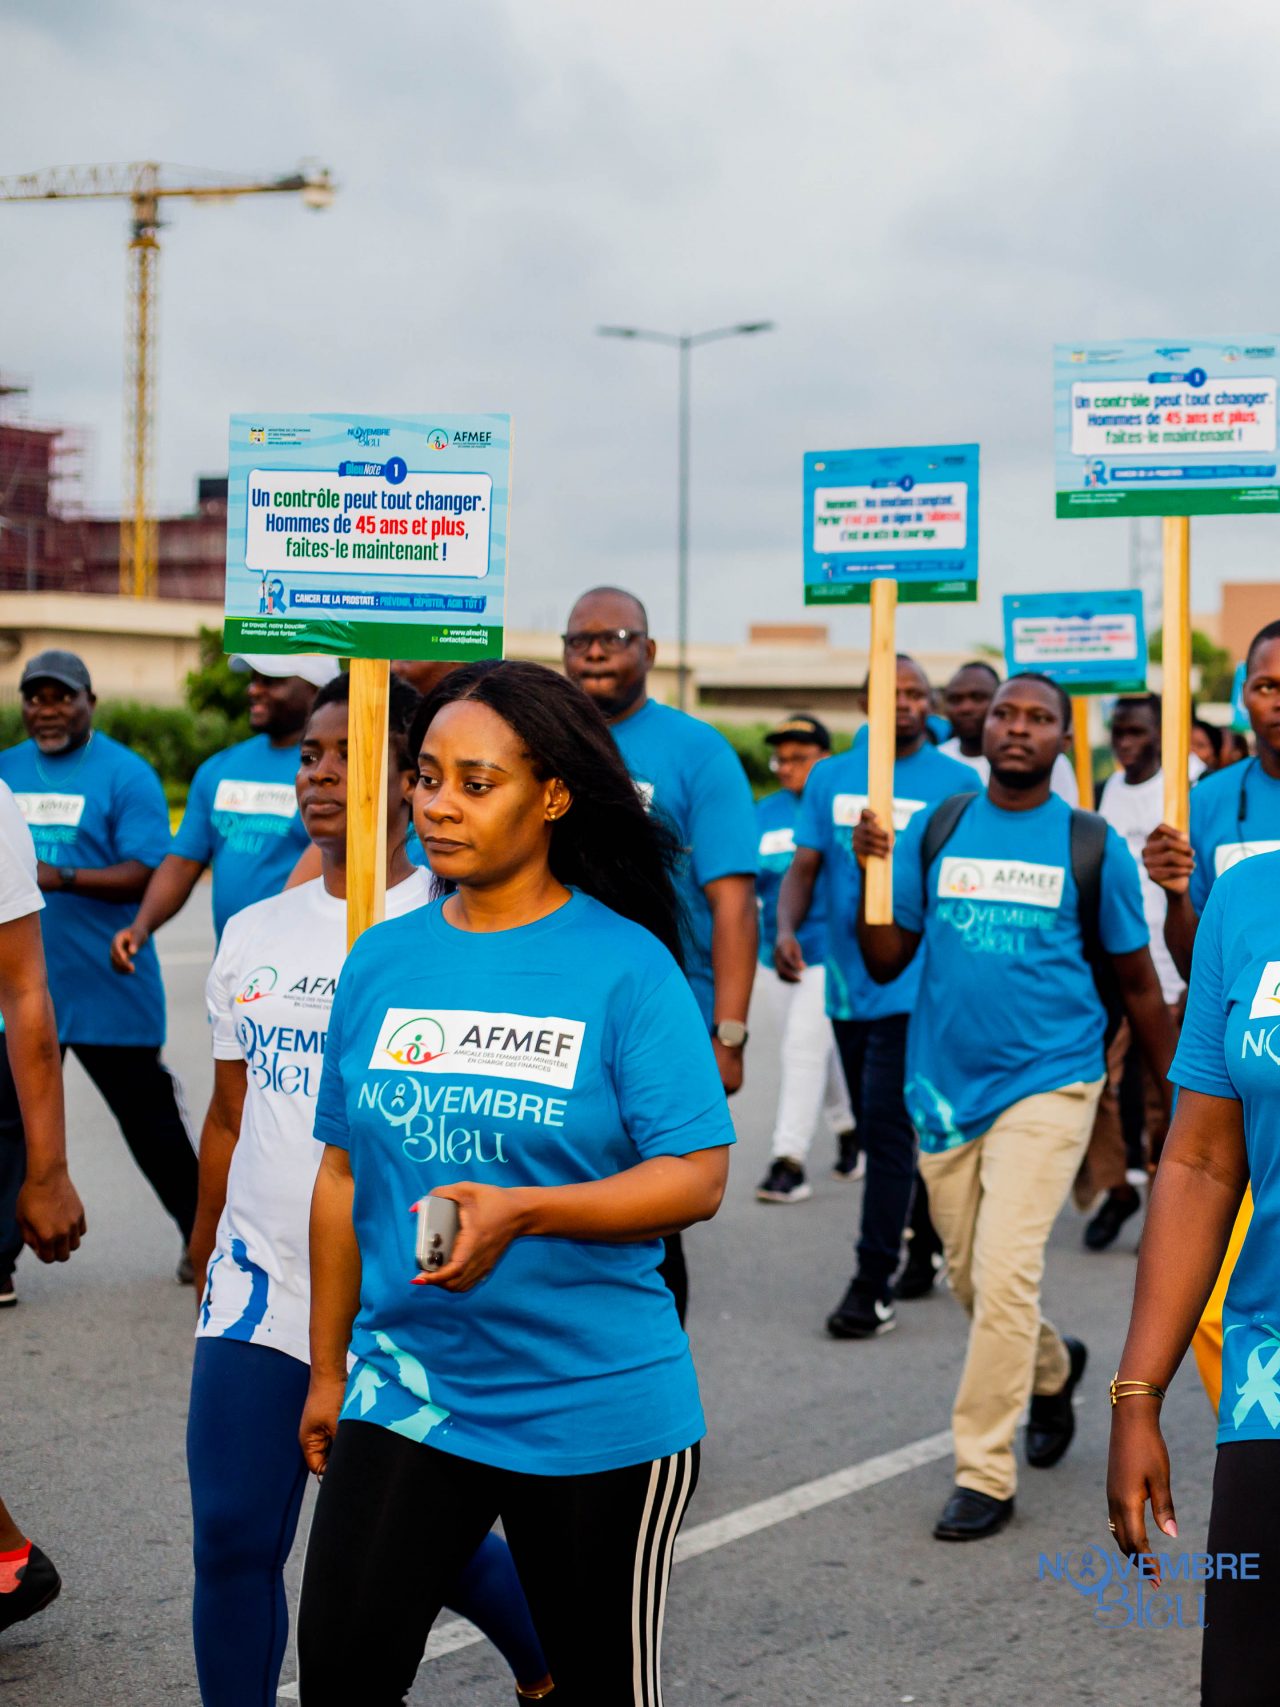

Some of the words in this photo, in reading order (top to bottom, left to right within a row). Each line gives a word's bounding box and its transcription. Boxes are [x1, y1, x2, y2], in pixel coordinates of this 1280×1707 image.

[1154, 393, 1180, 409] peut
[1185, 393, 1210, 406] tout
[1088, 413, 1142, 426] Hommes
[1146, 413, 1160, 425] de
[1165, 412, 1181, 424] 45
[1186, 413, 1207, 424] ans
[1213, 411, 1225, 423] et
[453, 432, 492, 442] AFMEF
[1163, 428, 1234, 443] maintenant
[394, 464, 399, 477] 1
[252, 488, 270, 507] Un
[274, 488, 340, 509] contrôle
[344, 491, 377, 513] peut
[381, 491, 412, 510] tout
[415, 490, 486, 515] changer.
[266, 513, 329, 534] Hommes
[333, 514, 351, 534] de
[355, 515, 376, 535] 45
[380, 518, 408, 536] ans
[412, 517, 427, 536] et
[431, 516, 469, 540] plus,
[286, 538, 349, 559] faites-le
[352, 540, 439, 561] maintenant
[442, 543, 447, 561] !
[295, 594, 321, 604] CANCER
[322, 594, 330, 604] DE
[332, 595, 340, 604] LA
[342, 595, 374, 606] PROSTATE
[994, 869, 1058, 888] AFMEF
[459, 1025, 574, 1057] AFMEF
[453, 1049, 482, 1057] AMICALE
[477, 1058, 504, 1067] CHARGE
[518, 1062, 551, 1072] FINANCES
[358, 1075, 568, 1127] NOVEMBRE
[402, 1114, 509, 1164] Bleu
